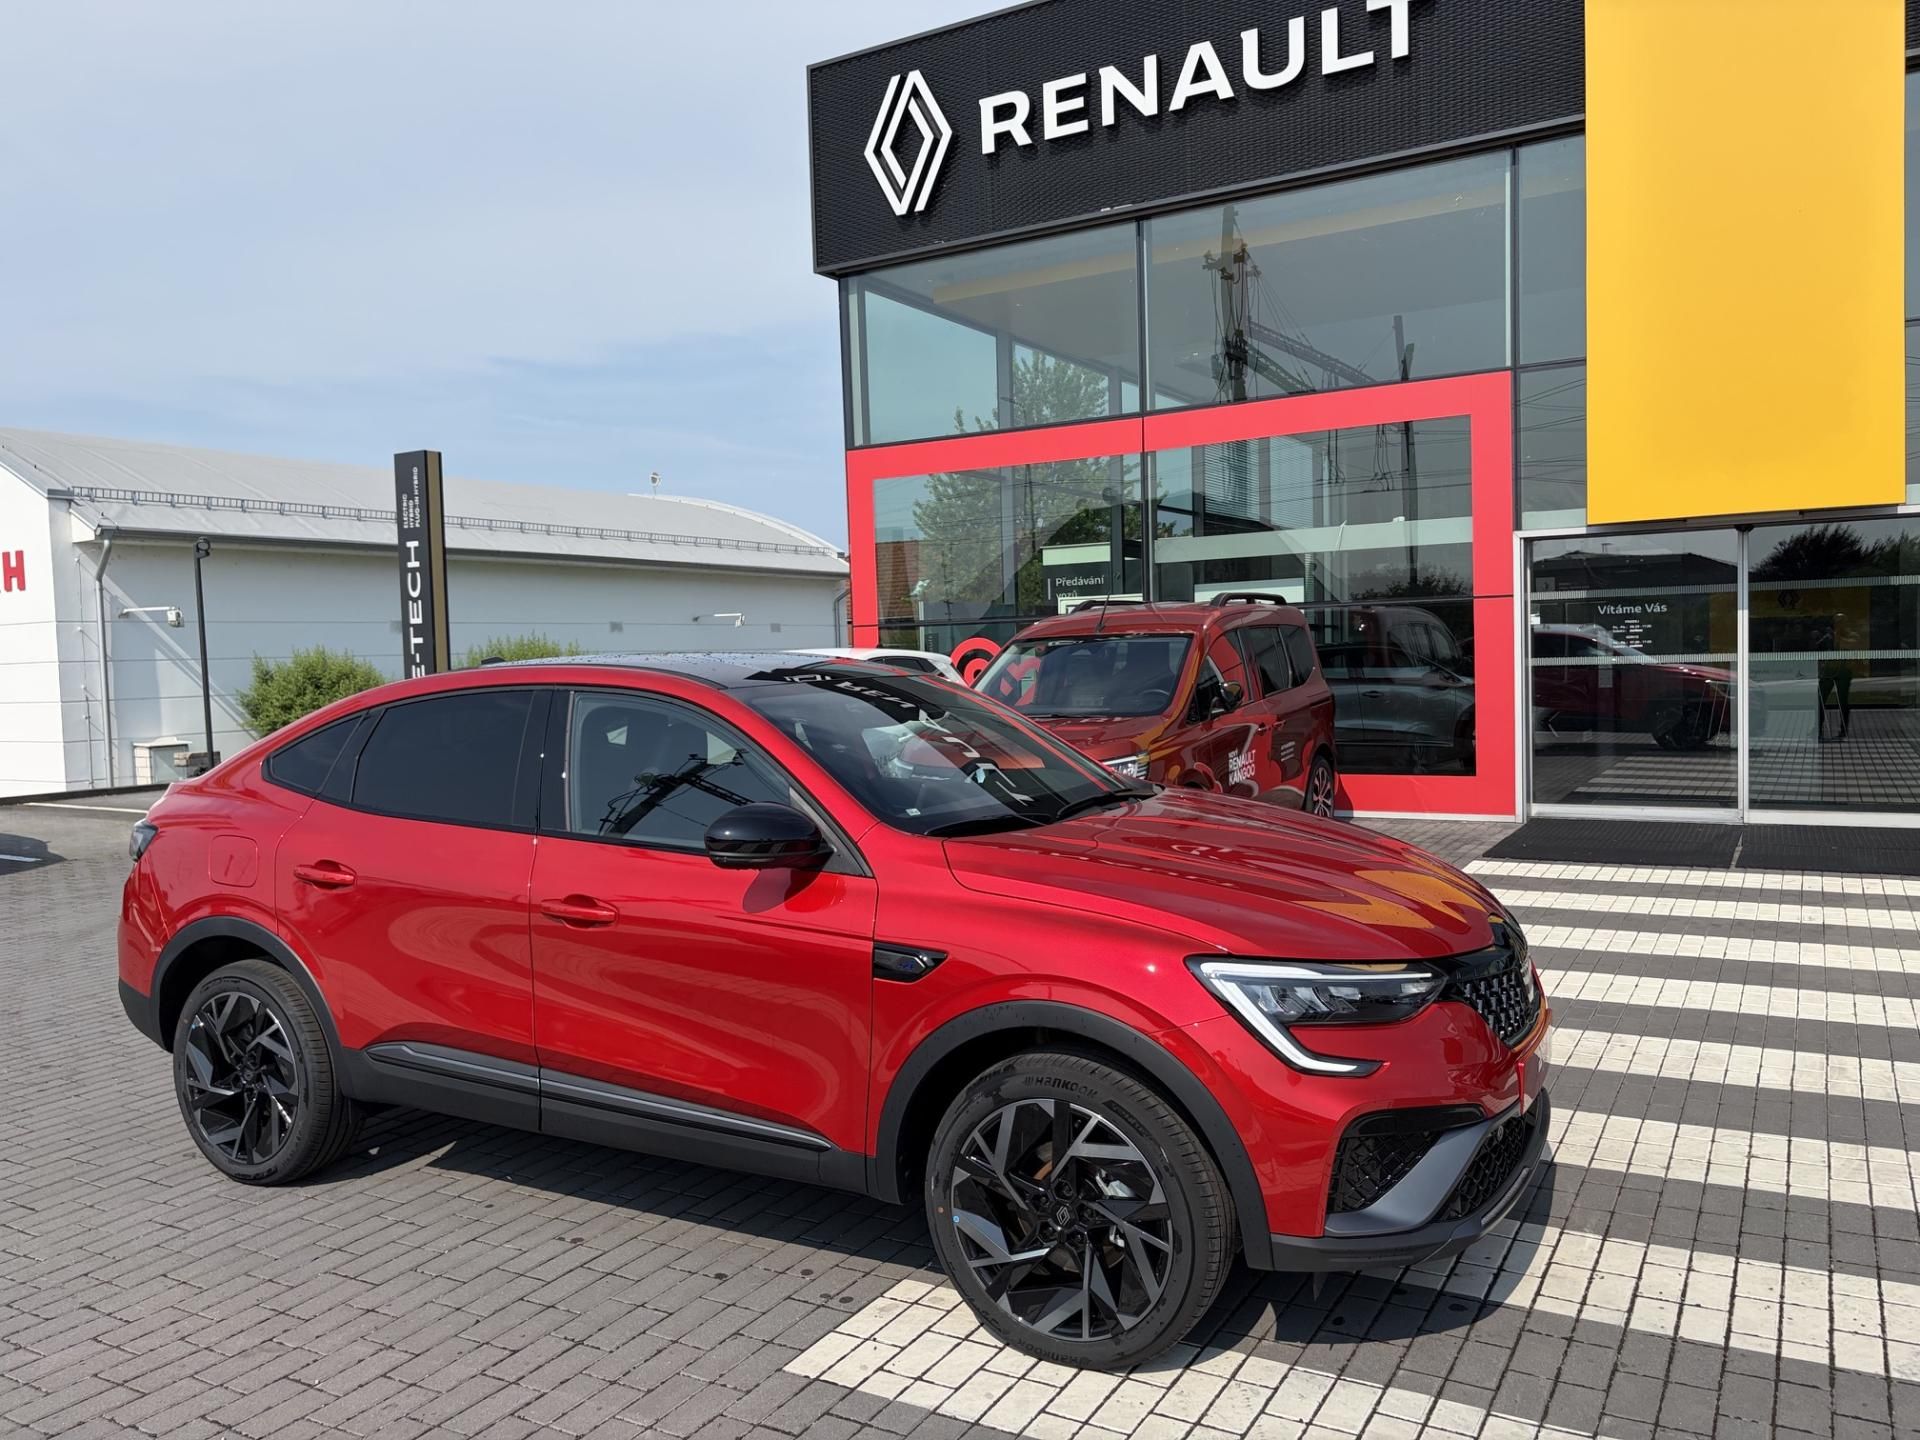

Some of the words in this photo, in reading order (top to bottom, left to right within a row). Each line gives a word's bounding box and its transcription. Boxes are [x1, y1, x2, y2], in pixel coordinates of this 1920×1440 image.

[979, 0, 1411, 154] RENAULT
[1055, 575, 1105, 587] Předávání
[1597, 604, 1642, 615] Vítáme
[1644, 602, 1668, 613] Vás
[1228, 749, 1256, 770] RENAULT
[1229, 763, 1256, 786] KANGOO
